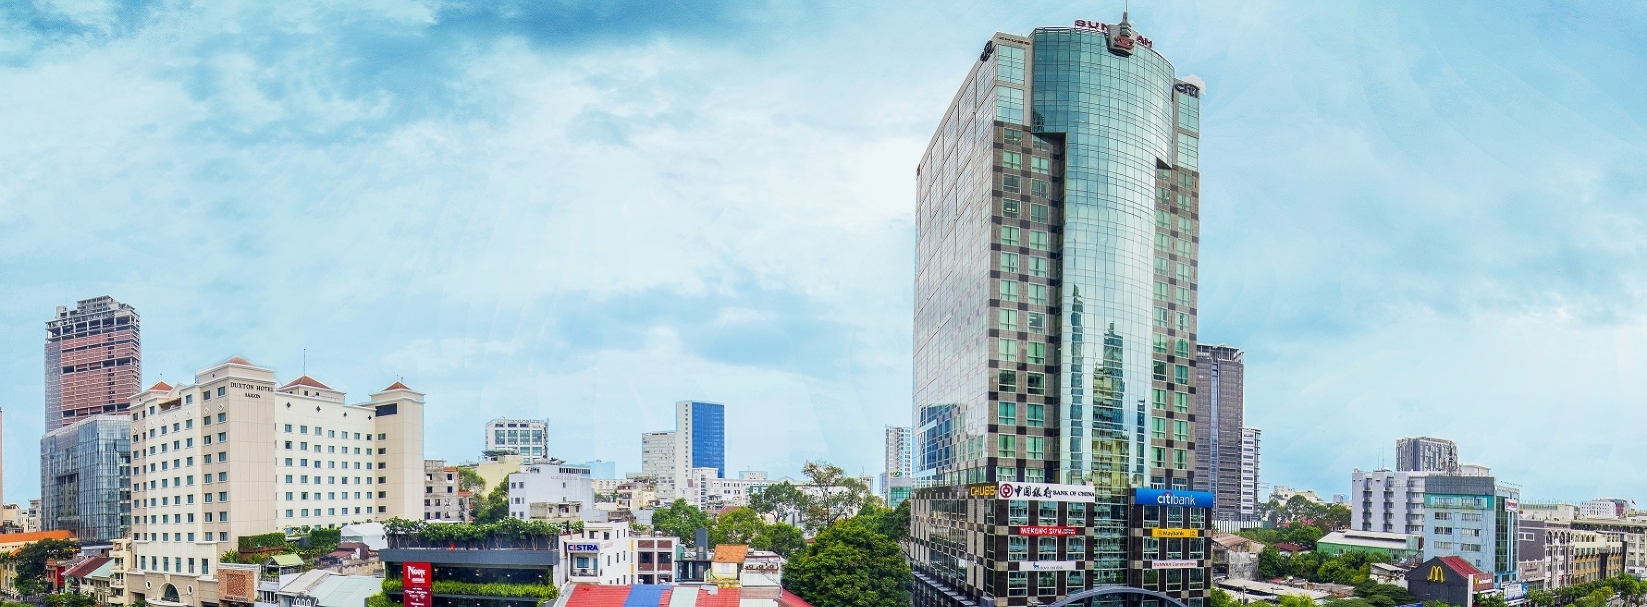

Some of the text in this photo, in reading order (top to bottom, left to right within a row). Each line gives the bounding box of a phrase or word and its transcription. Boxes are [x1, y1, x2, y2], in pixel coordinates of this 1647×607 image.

[970, 485, 997, 497] CHUBB
[1053, 488, 1068, 496] BANK
[1078, 490, 1095, 498] CHINA
[1157, 494, 1196, 506] citibank
